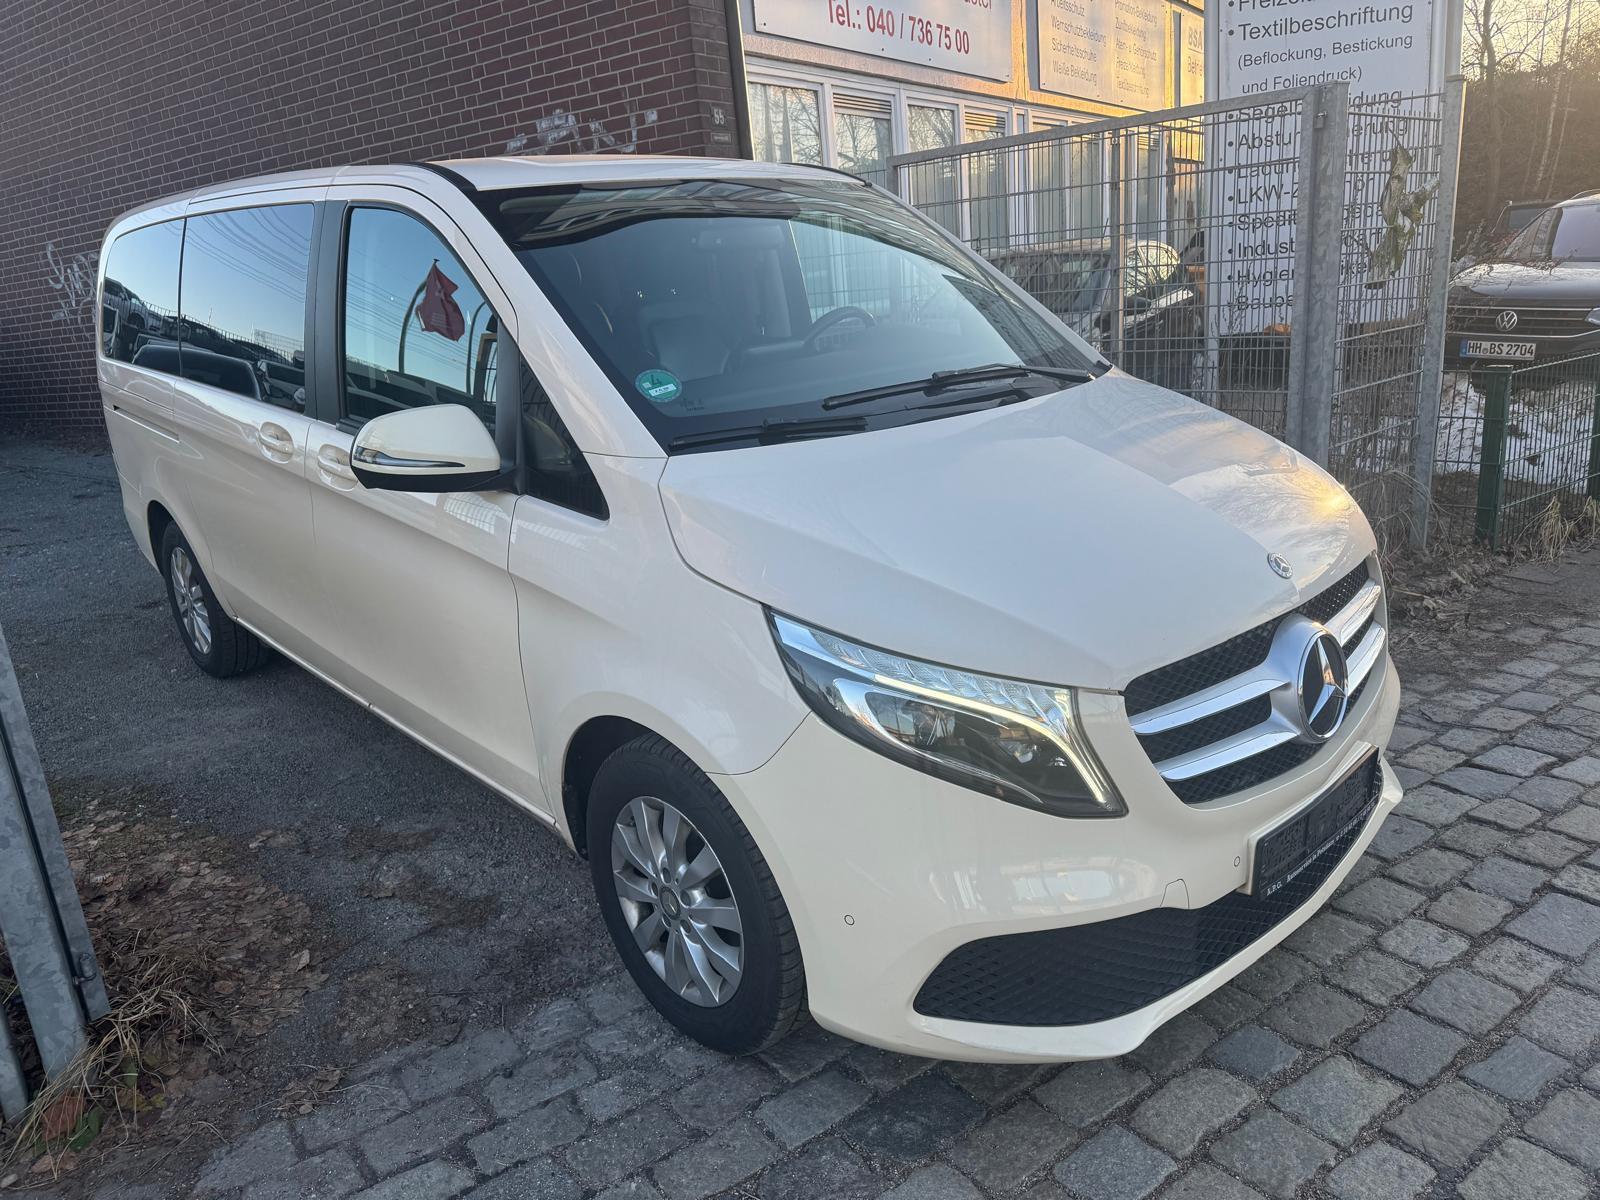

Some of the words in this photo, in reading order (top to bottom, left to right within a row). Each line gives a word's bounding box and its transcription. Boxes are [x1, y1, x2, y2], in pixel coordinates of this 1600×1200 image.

[827, 0, 861, 30] Tel.:
[866, 5, 895, 37] 040
[899, 13, 904, 40] /
[908, 16, 933, 46] 736
[936, 23, 951, 51] 75
[955, 28, 970, 55] 00
[1238, 4, 1414, 41] Textilbeschriftung
[1237, 47, 1327, 70] (Beflockung,
[1332, 34, 1413, 56] Bestickung
[1241, 78, 1269, 94] und
[1273, 66, 1363, 91] Foliendruck)
[1467, 341, 1482, 355] HH
[1489, 343, 1504, 355] BS
[1506, 344, 1534, 356] 2704
